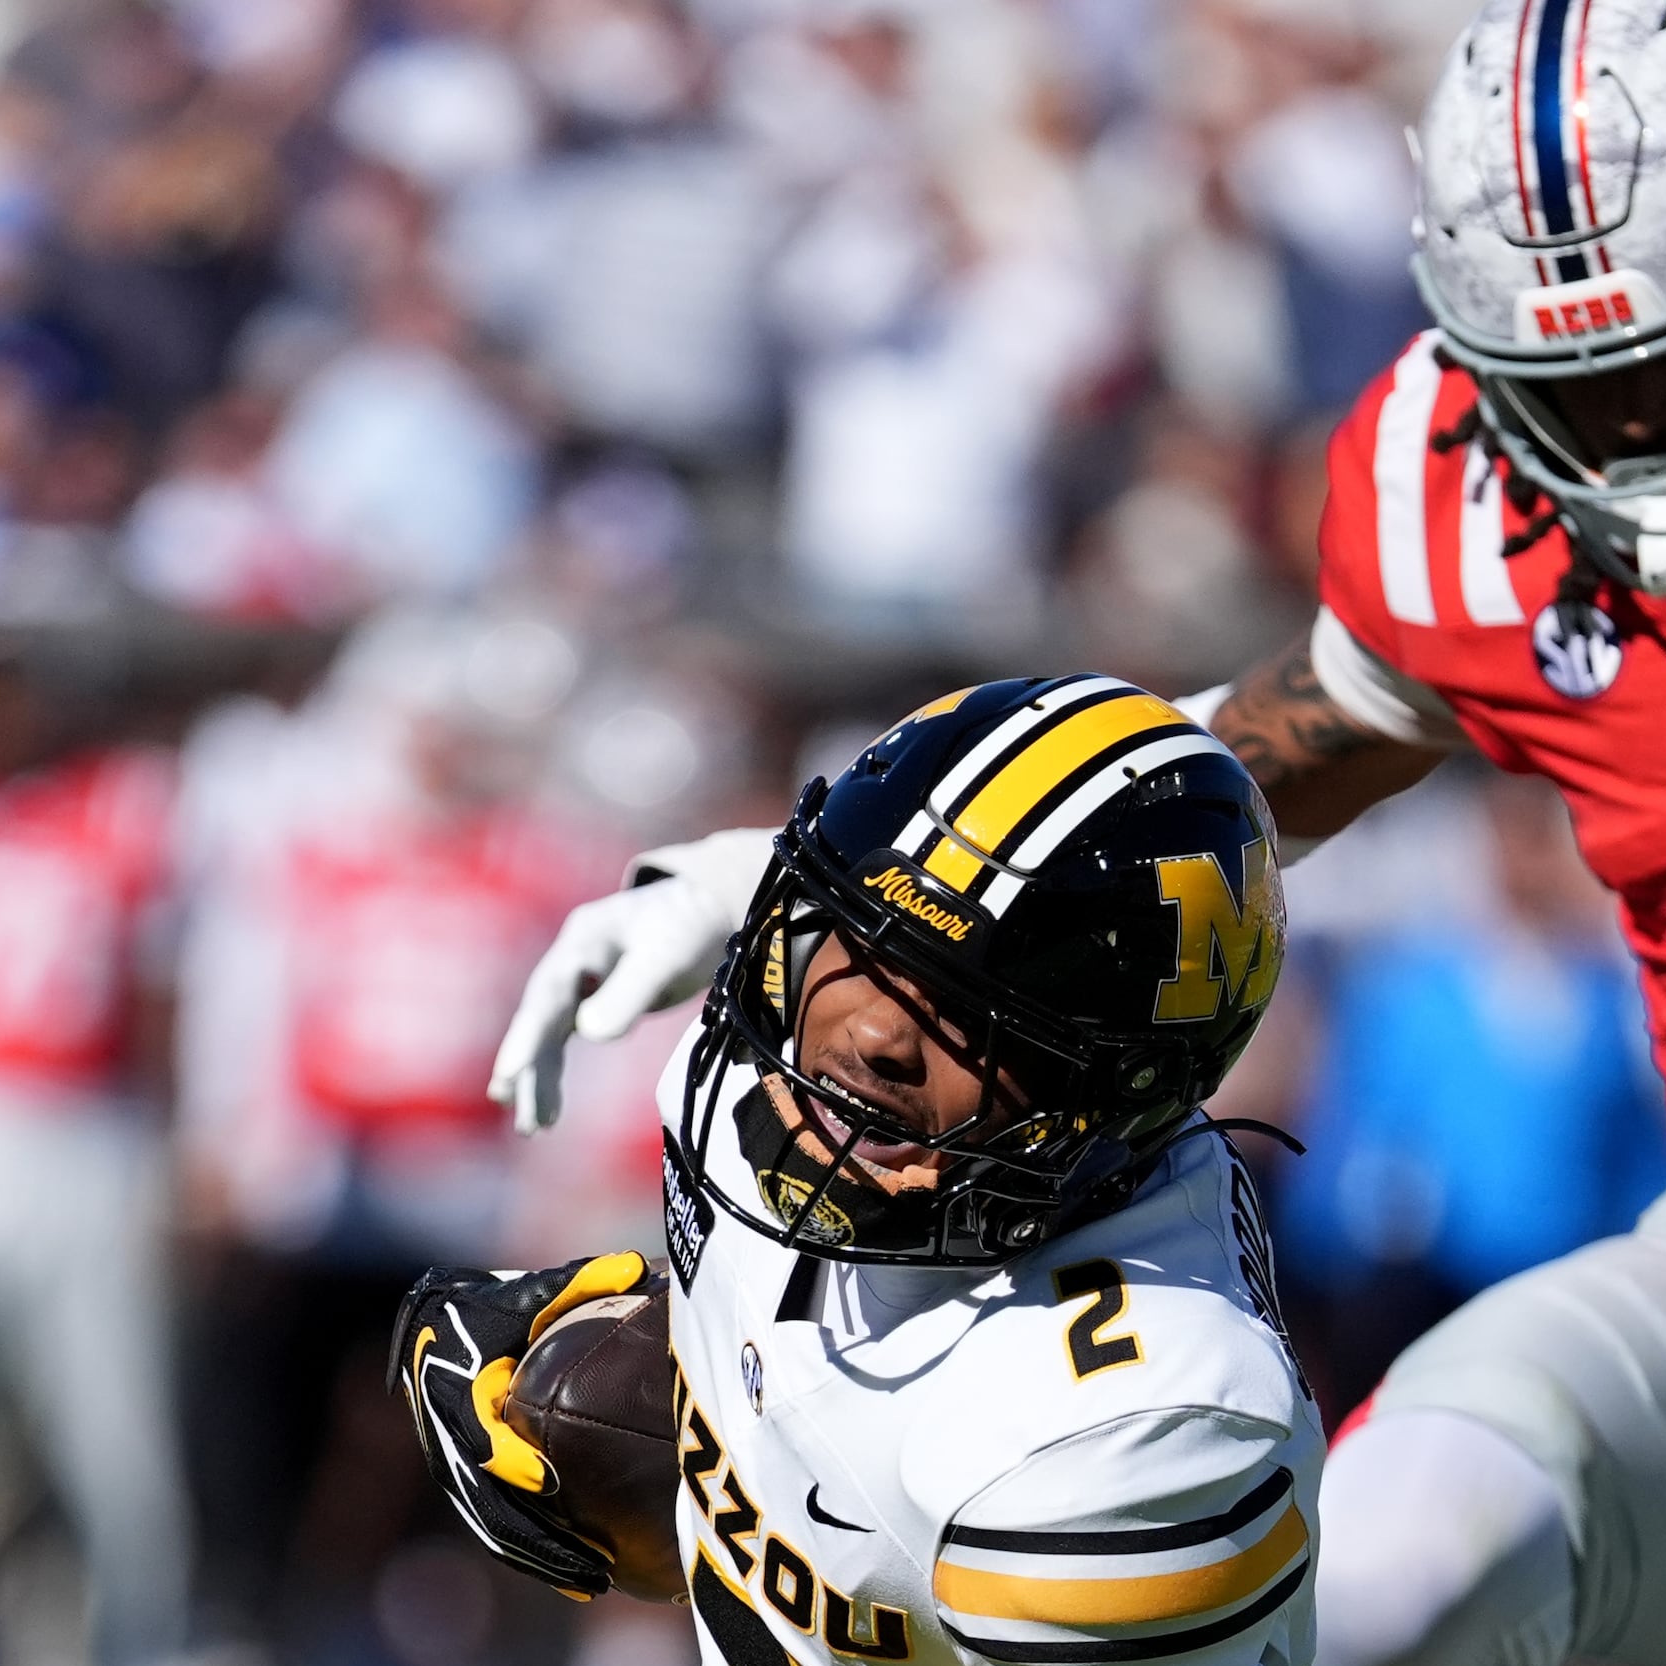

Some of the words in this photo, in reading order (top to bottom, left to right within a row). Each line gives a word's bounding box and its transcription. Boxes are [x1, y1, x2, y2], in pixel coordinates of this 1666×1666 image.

[863, 866, 974, 942] Missouri
[1152, 835, 1283, 1024] M
[1051, 1256, 1145, 1386] 2
